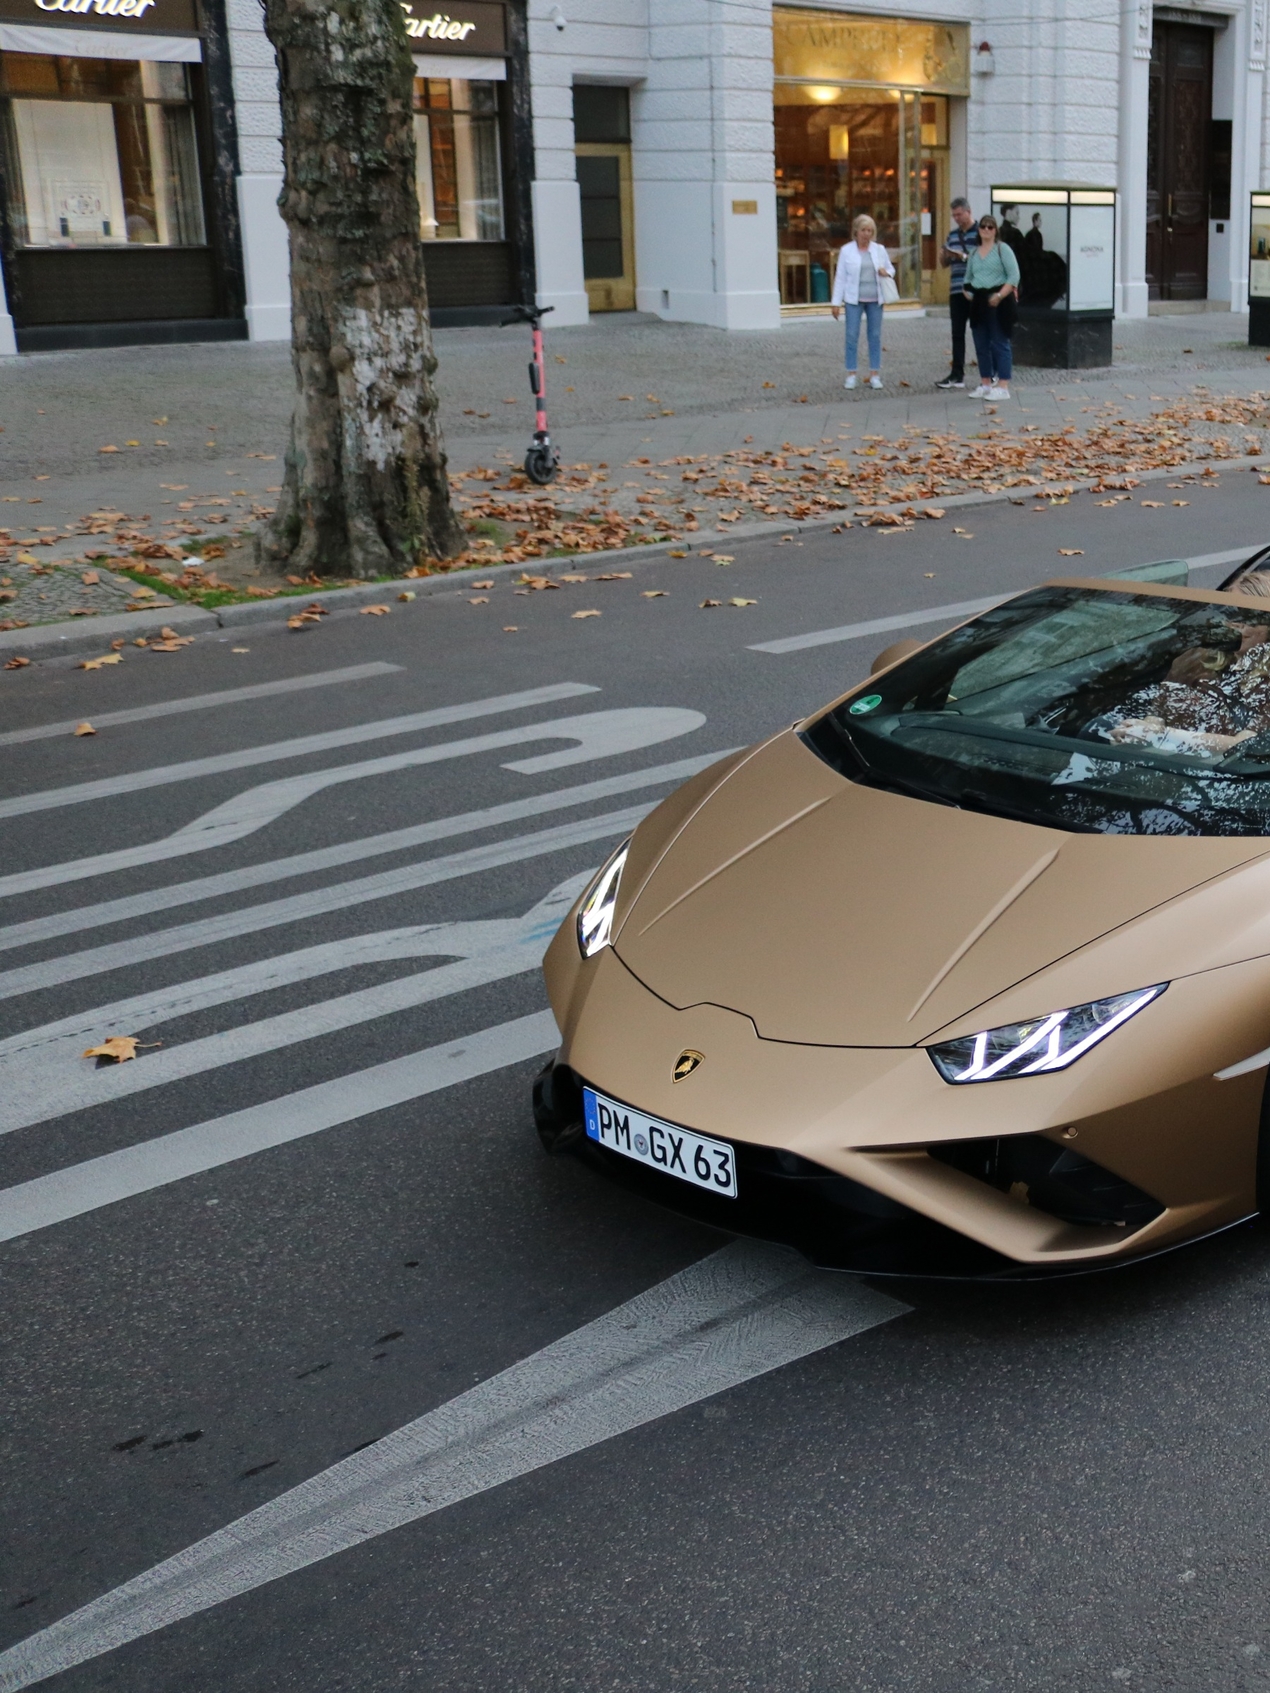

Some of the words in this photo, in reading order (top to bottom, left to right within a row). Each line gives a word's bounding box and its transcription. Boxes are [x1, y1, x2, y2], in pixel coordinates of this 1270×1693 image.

[400, 2, 477, 40] artier
[589, 1119, 596, 1131] D
[597, 1103, 631, 1151] PM
[649, 1126, 687, 1174] GX
[694, 1144, 731, 1188] 63
